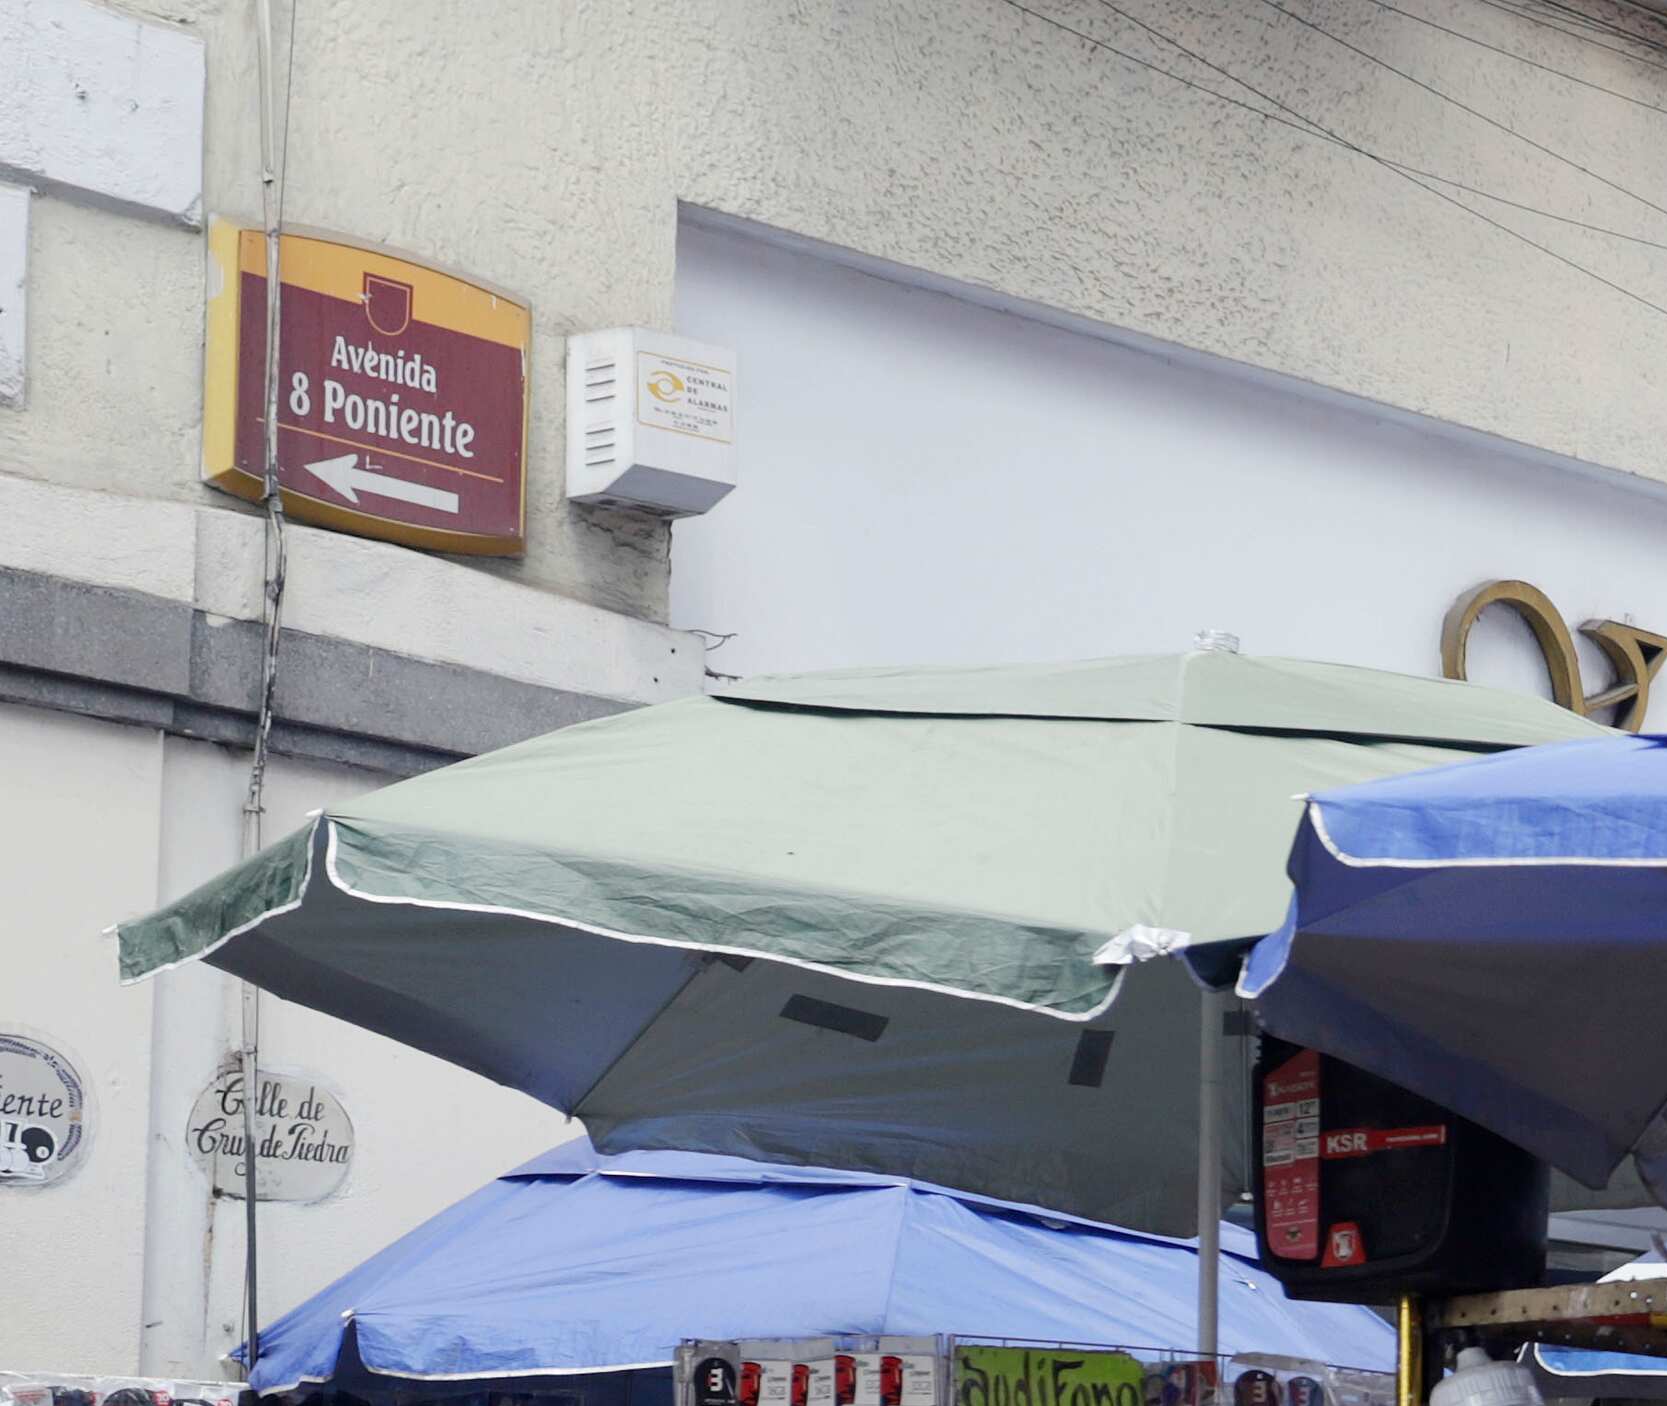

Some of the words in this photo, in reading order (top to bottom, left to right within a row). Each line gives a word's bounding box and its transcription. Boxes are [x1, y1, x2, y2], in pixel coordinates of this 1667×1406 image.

[331, 335, 437, 393] Avenida
[687, 376, 729, 392] CENTRAL
[289, 371, 311, 416] 8
[324, 379, 475, 458] Poniente
[688, 398, 729, 412] ALARMAS
[215, 1077, 288, 1119] Clle
[297, 1086, 325, 1121] de
[192, 1118, 247, 1162] Cru
[260, 1124, 283, 1158] de
[281, 1123, 349, 1163] Piedra
[1326, 1132, 1368, 1153] KSR
